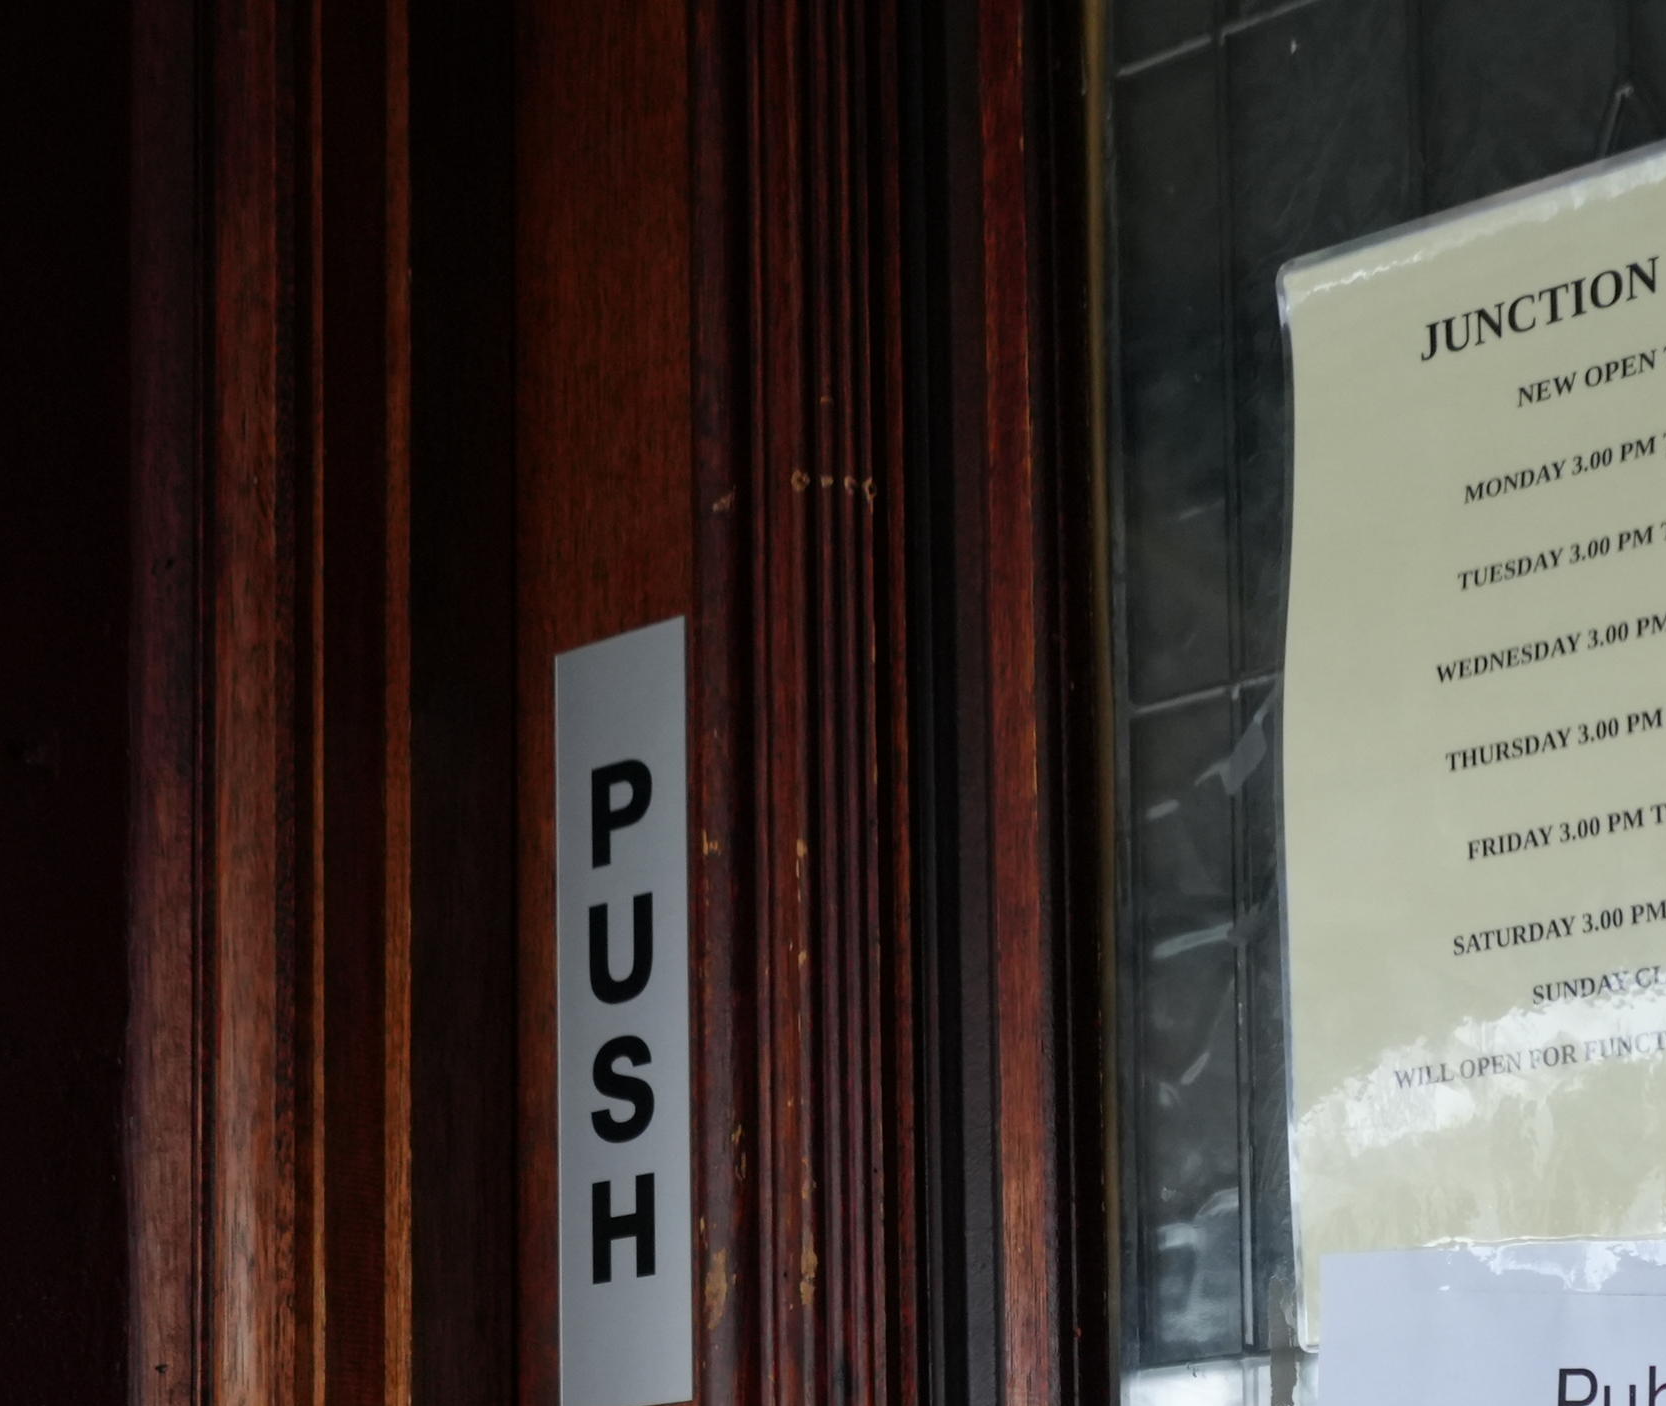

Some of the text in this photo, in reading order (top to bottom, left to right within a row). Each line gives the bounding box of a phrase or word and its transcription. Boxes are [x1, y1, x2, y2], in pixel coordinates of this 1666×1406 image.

[1420, 256, 1660, 362] JUNCTION
[1517, 372, 1577, 408] NEW
[1583, 350, 1657, 389] OPEN
[1463, 459, 1566, 504] MONDAY
[1571, 446, 1613, 477] 3.00
[1619, 436, 1657, 463] PM
[1457, 547, 1564, 591] TUESDAY
[1569, 536, 1610, 564] 3.00
[1617, 525, 1654, 552] PM
[1436, 632, 1582, 684] WEDNESDAY
[1587, 622, 1629, 650] 3.00
[1445, 727, 1572, 772] THURSDAY
[1578, 717, 1620, 745] 3.00
[1626, 708, 1663, 735] PM
[1467, 825, 1554, 860] FRIDAY
[1559, 815, 1601, 843] 3.00
[1607, 806, 1644, 834] PM
[1453, 915, 1576, 957] SATURDAY
[1581, 906, 1623, 934] 3.00
[1532, 971, 1629, 1005] SUNDAY
[587, 758, 656, 1285] PUSH
[1394, 1059, 1455, 1090] WILL
[1460, 1050, 1522, 1082] OPEN
[1529, 1044, 1578, 1070] FOR
